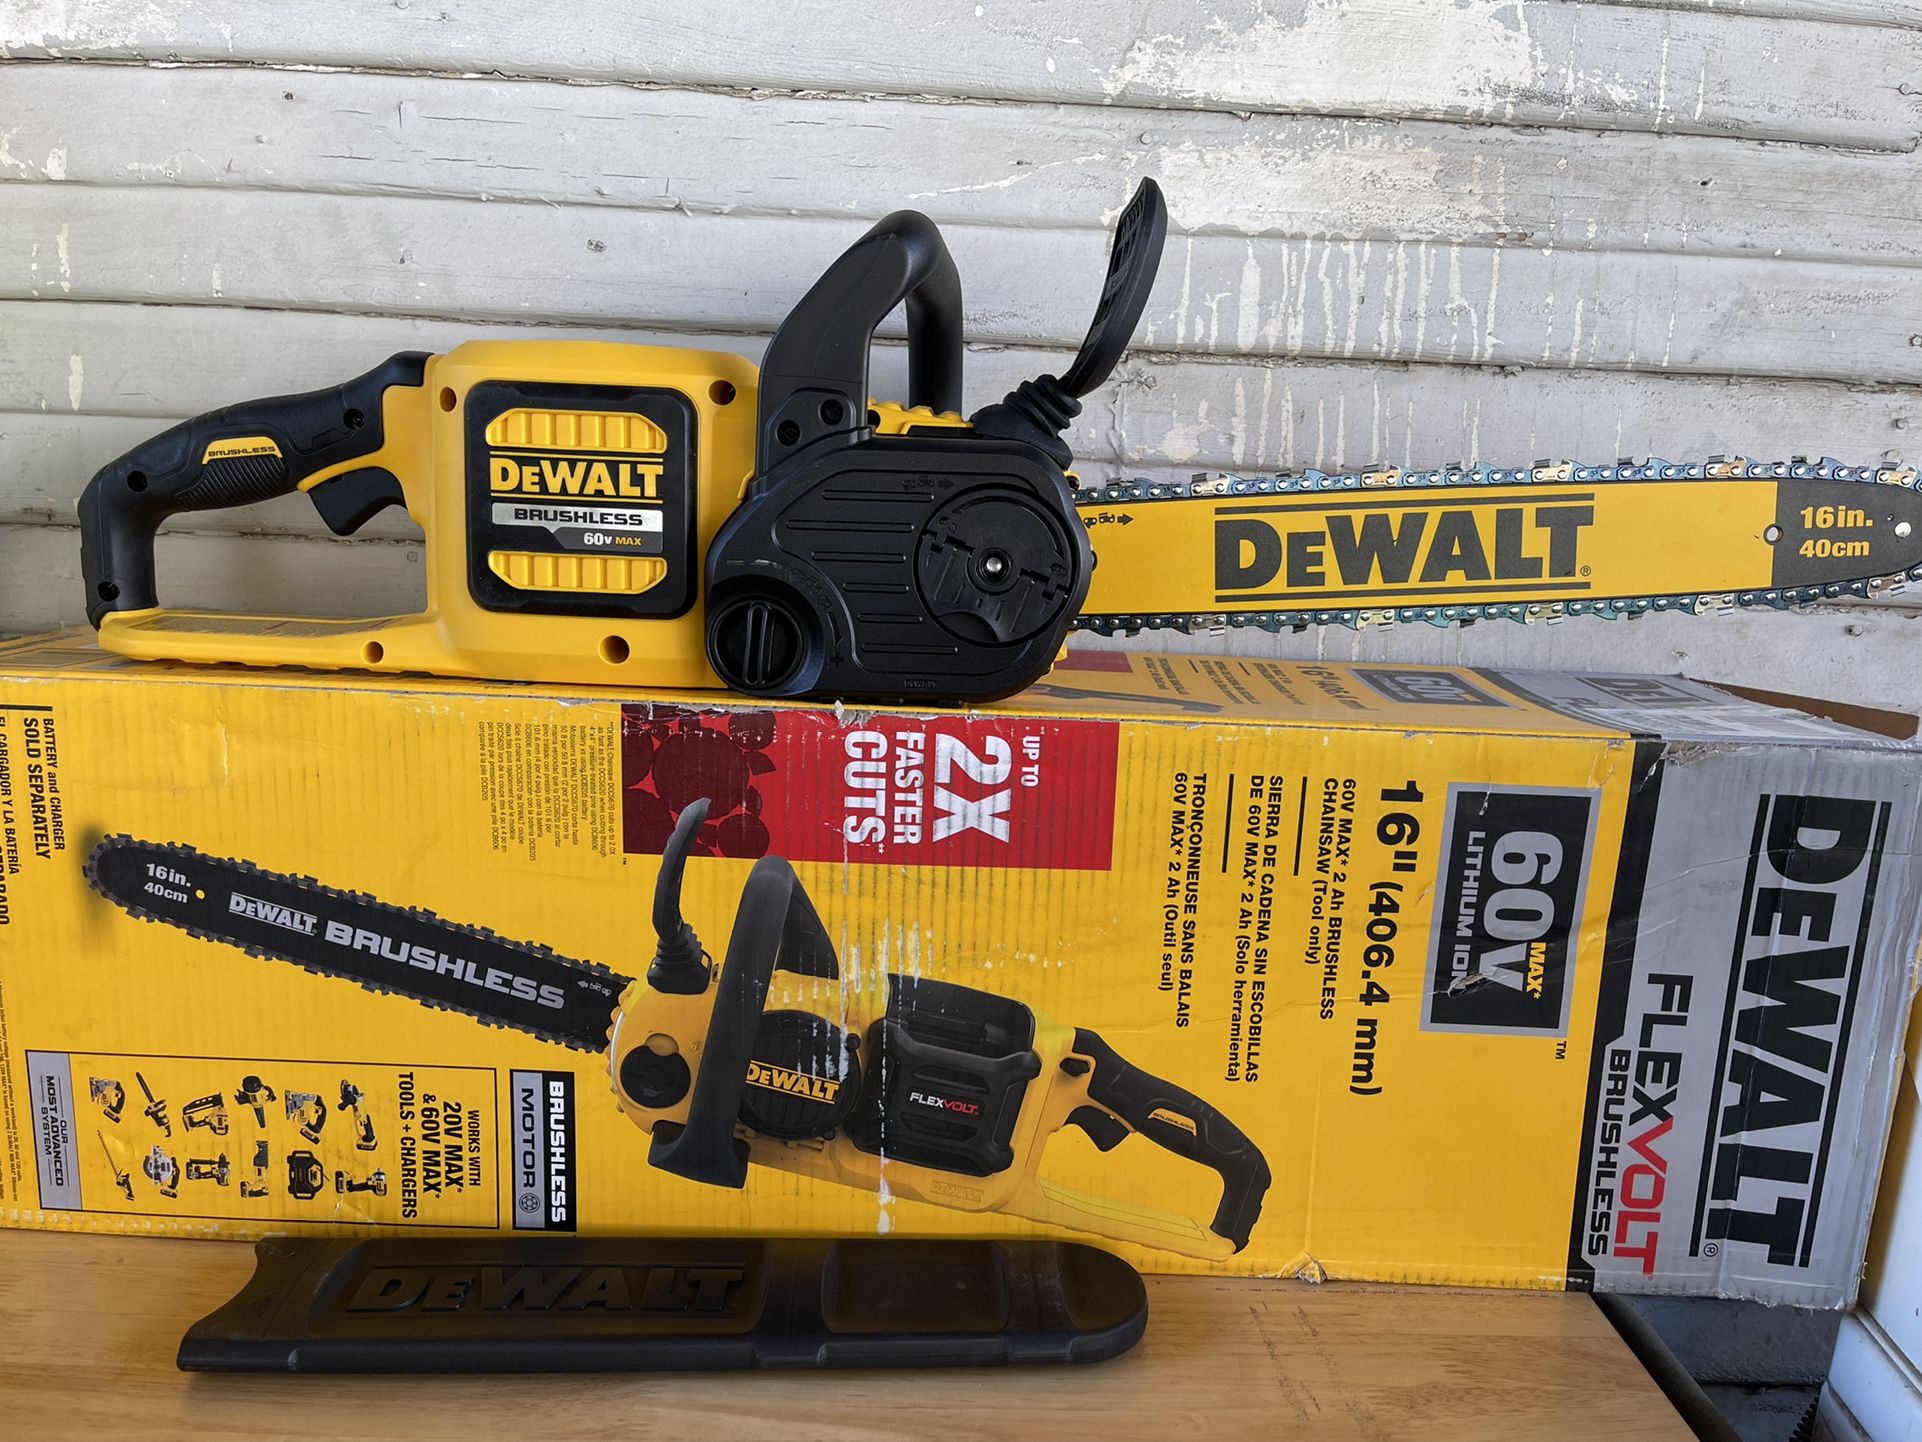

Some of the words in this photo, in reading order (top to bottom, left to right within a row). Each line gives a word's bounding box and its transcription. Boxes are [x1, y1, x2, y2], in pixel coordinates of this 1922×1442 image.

[208, 445, 276, 459] BRUSHLESS
[514, 509, 644, 526] BRUSHLESS
[584, 534, 612, 546] 60V
[616, 537, 641, 546] MAX
[1799, 538, 1870, 558] 40cm
[23, 717, 41, 758] SOLD
[43, 718, 58, 768] BATTERY
[1023, 736, 1040, 760] UP
[0, 733, 12, 796] CARGADOR
[47, 772, 60, 793] and
[1021, 765, 1039, 786] TO
[2, 799, 13, 807] Y
[894, 732, 925, 844] FASTER
[932, 733, 1012, 843] 2X
[1173, 772, 1188, 805] 60V
[1250, 775, 1264, 799] DE
[1265, 775, 1283, 839] SIERRA
[1340, 779, 1356, 813] 60V
[3, 810, 14, 824] LA
[28, 764, 51, 859] SEPARATELY
[50, 797, 65, 850] CHARGER
[1247, 805, 1261, 837] 60V
[1316, 778, 1338, 874] CHAINSAW
[1376, 781, 1424, 872] 16"
[5, 828, 20, 874] BATERÍA
[1184, 773, 1207, 914] TRONÇONNEUSE
[1262, 845, 1277, 867] DE
[1168, 861, 1181, 872] 2
[1333, 872, 1346, 883] 2
[1455, 831, 1486, 936] LITHIUM
[144, 882, 188, 903] 40cm
[1167, 877, 1180, 898] Ah
[1241, 893, 1254, 903] 2
[1311, 880, 1328, 920] (Tool
[1330, 888, 1345, 910] Ah
[1163, 904, 1179, 947] (Outil
[1239, 908, 1253, 929] Ah
[1256, 873, 1274, 943] CADENA
[1479, 831, 1564, 991] 60V
[1180, 920, 1196, 964] SANS
[1235, 935, 1251, 974] (Solo
[1253, 948, 1268, 975] SIN
[1304, 926, 1321, 964] only)
[1359, 882, 1403, 1006] (406.4
[325, 920, 564, 1009] BRUSHLESS
[1158, 953, 1173, 991] seul)
[1320, 917, 1342, 1019] BRUSHLESS
[1449, 945, 1471, 990] ION
[1176, 969, 1192, 1028] BALAIS
[1225, 980, 1247, 1081] herramienta)
[1245, 981, 1265, 1082] ESCOBILLAS
[1350, 1019, 1382, 1095] mm)
[47, 1076, 58, 1114] MOST
[399, 1072, 415, 1120] TOOLS
[423, 1094, 436, 1104] &
[909, 1091, 979, 1115] FLEXVOLT
[41, 1107, 52, 1155] SYSTEM
[60, 1120, 68, 1143] OUR
[402, 1124, 411, 1132] +
[421, 1108, 440, 1144] 60V
[443, 1101, 462, 1138] 20V
[468, 1110, 480, 1152] WORKS
[522, 1088, 535, 1188] MOTOR
[1614, 973, 1695, 1276] FLEXVOLT
[50, 1116, 64, 1186] ADVANCED
[469, 1156, 480, 1186] WITH
[550, 1081, 566, 1222] BRUSHLESS
[1588, 1048, 1633, 1256] BRUSHLESS
[401, 1137, 417, 1218] CHARGERS
